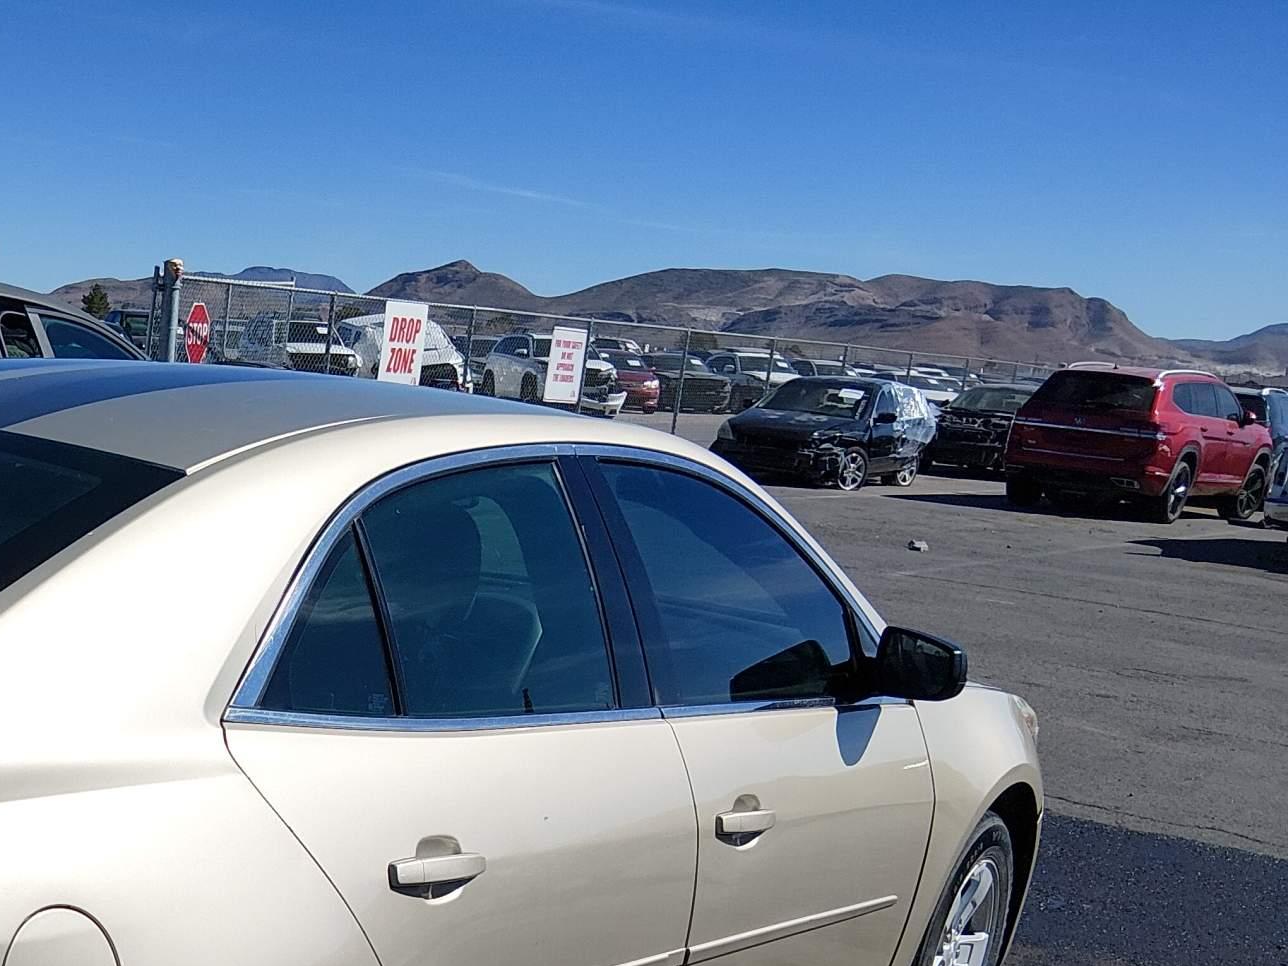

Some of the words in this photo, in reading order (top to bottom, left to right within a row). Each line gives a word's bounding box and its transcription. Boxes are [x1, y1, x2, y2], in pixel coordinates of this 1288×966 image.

[187, 322, 208, 345] STOP
[389, 316, 422, 344] DROP
[385, 348, 417, 374] ZONE
